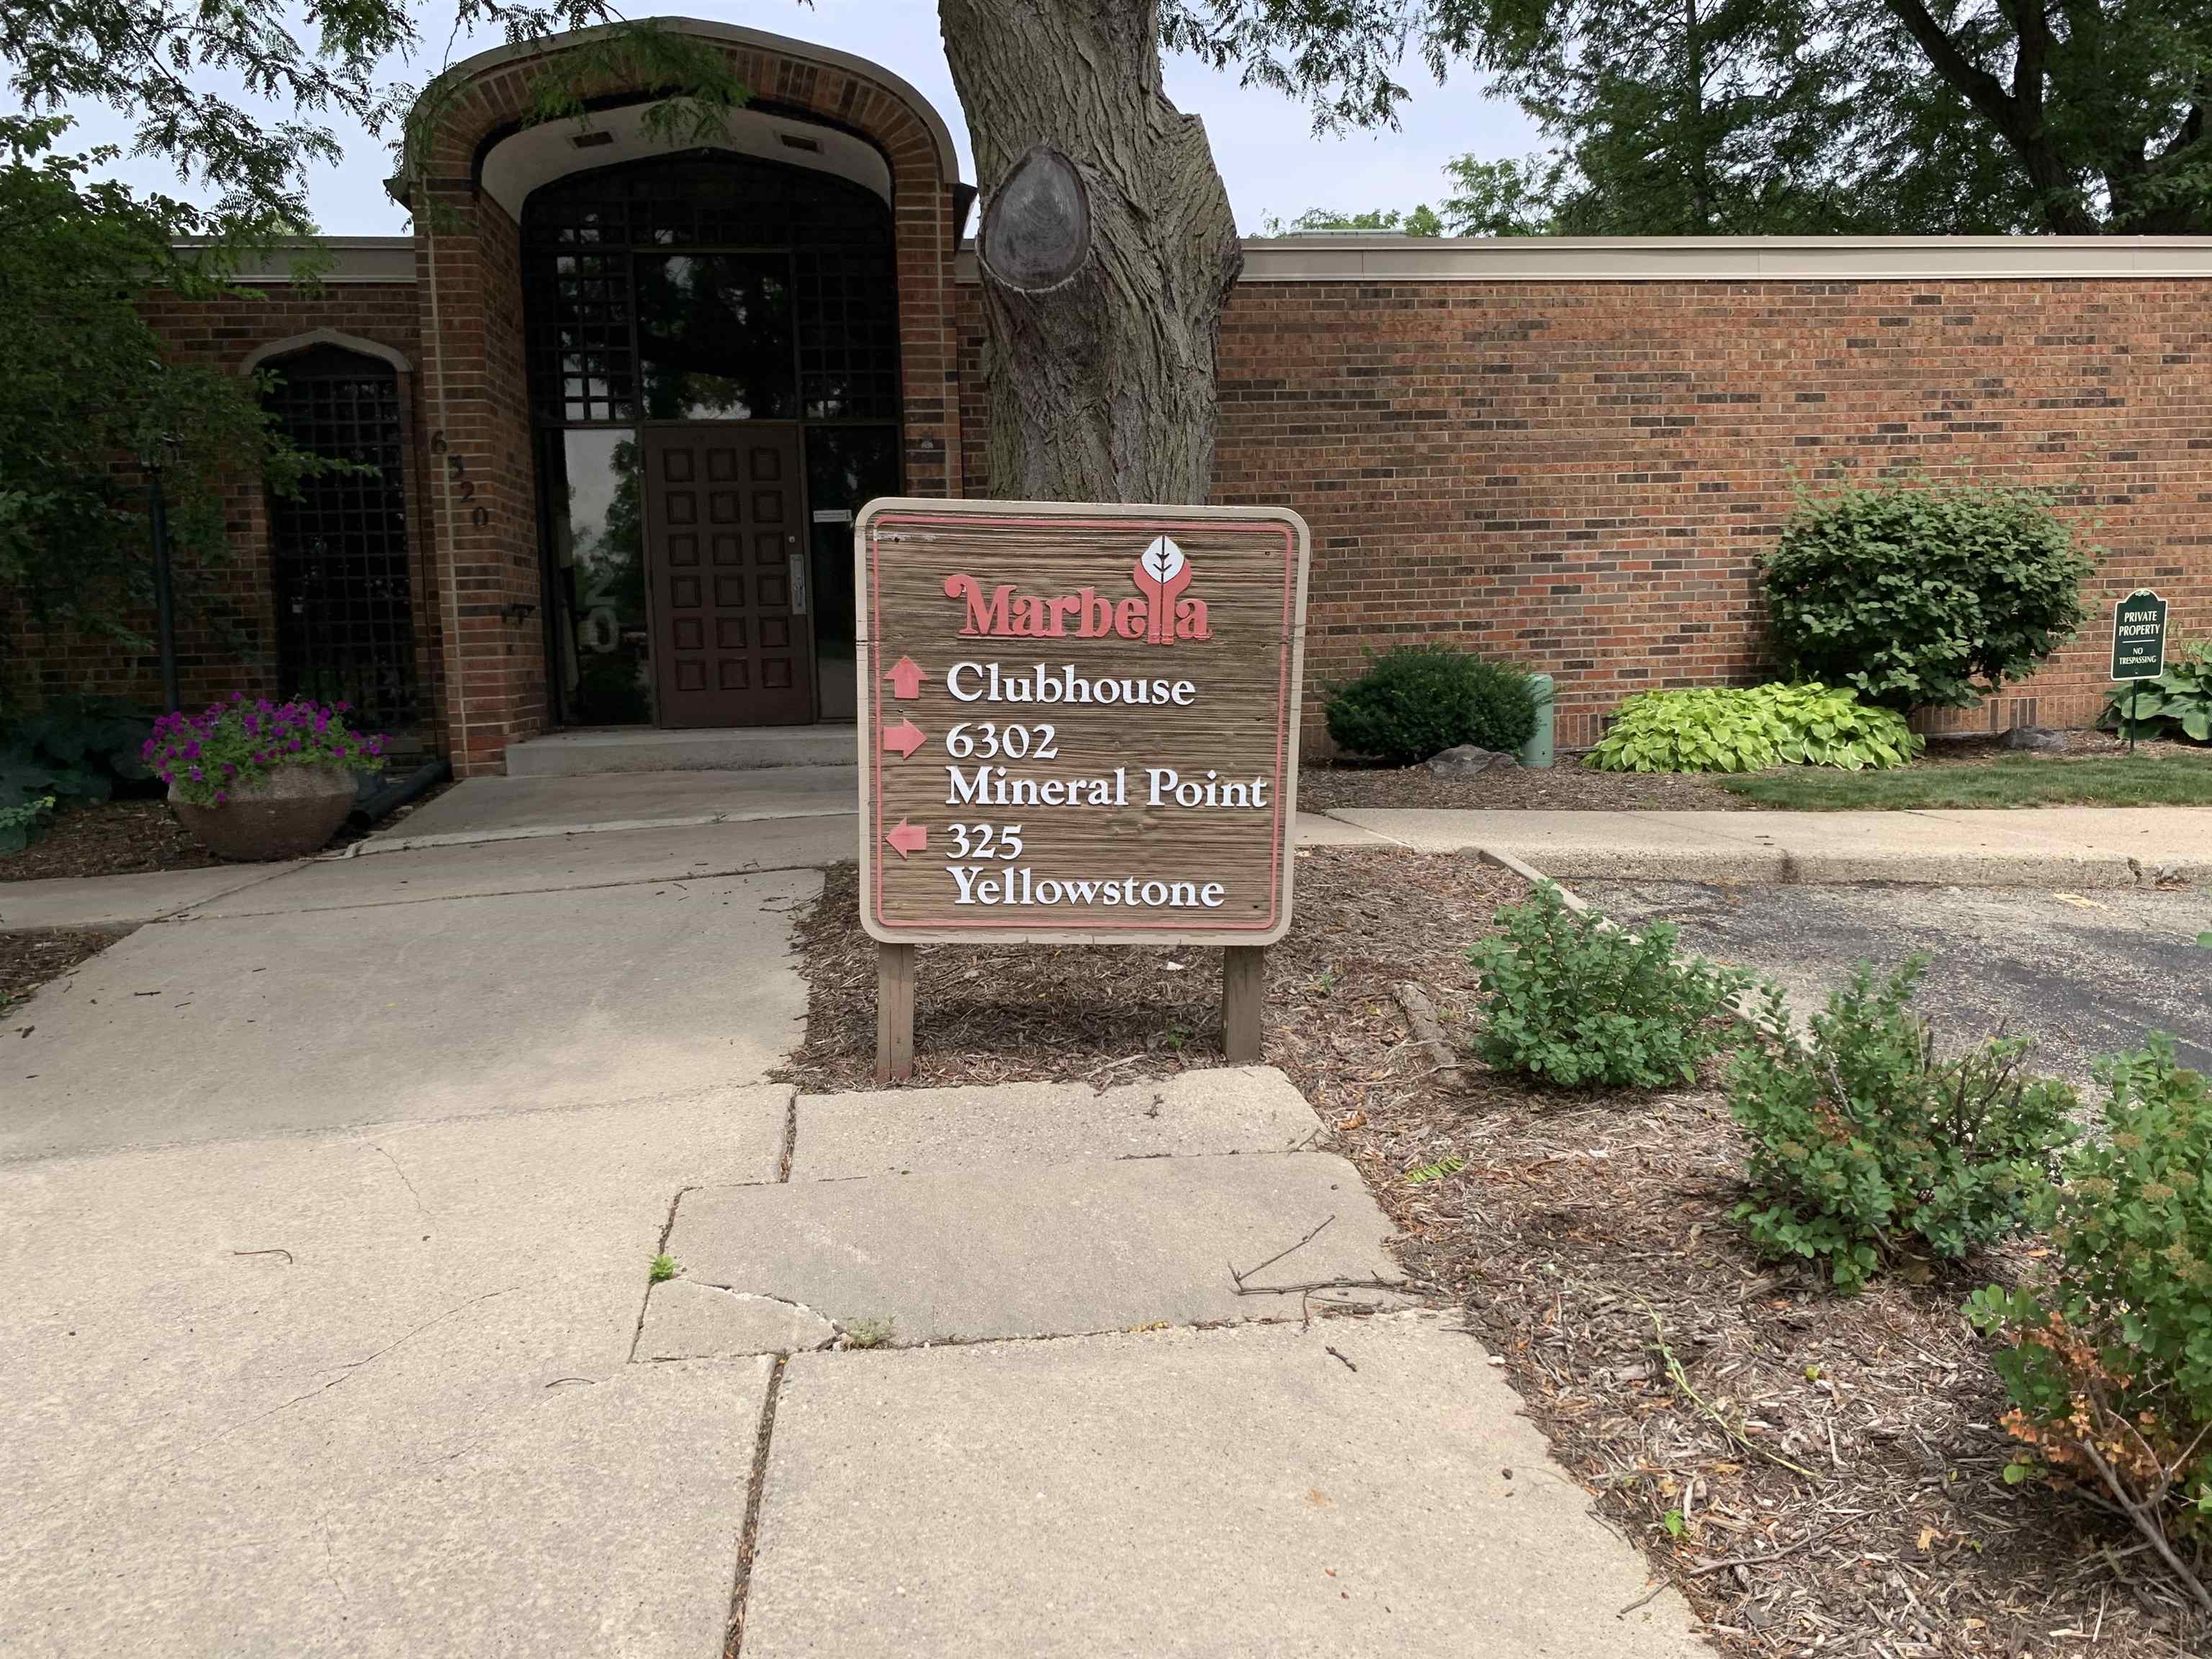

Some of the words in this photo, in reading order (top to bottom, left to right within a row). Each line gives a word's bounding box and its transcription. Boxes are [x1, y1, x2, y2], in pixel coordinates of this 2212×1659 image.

[944, 562, 1214, 645] Marbella
[2124, 611, 2157, 622] PRIVATE
[2118, 624, 2160, 637] PROPERTY
[2119, 655, 2157, 665] TRESPASSING
[945, 661, 1197, 706] Clubhouse
[945, 721, 1059, 760] 6302
[945, 765, 1129, 807] Mineral
[1145, 768, 1268, 809] Point
[945, 822, 1024, 861] 325
[945, 865, 1226, 908] Yellowstone
